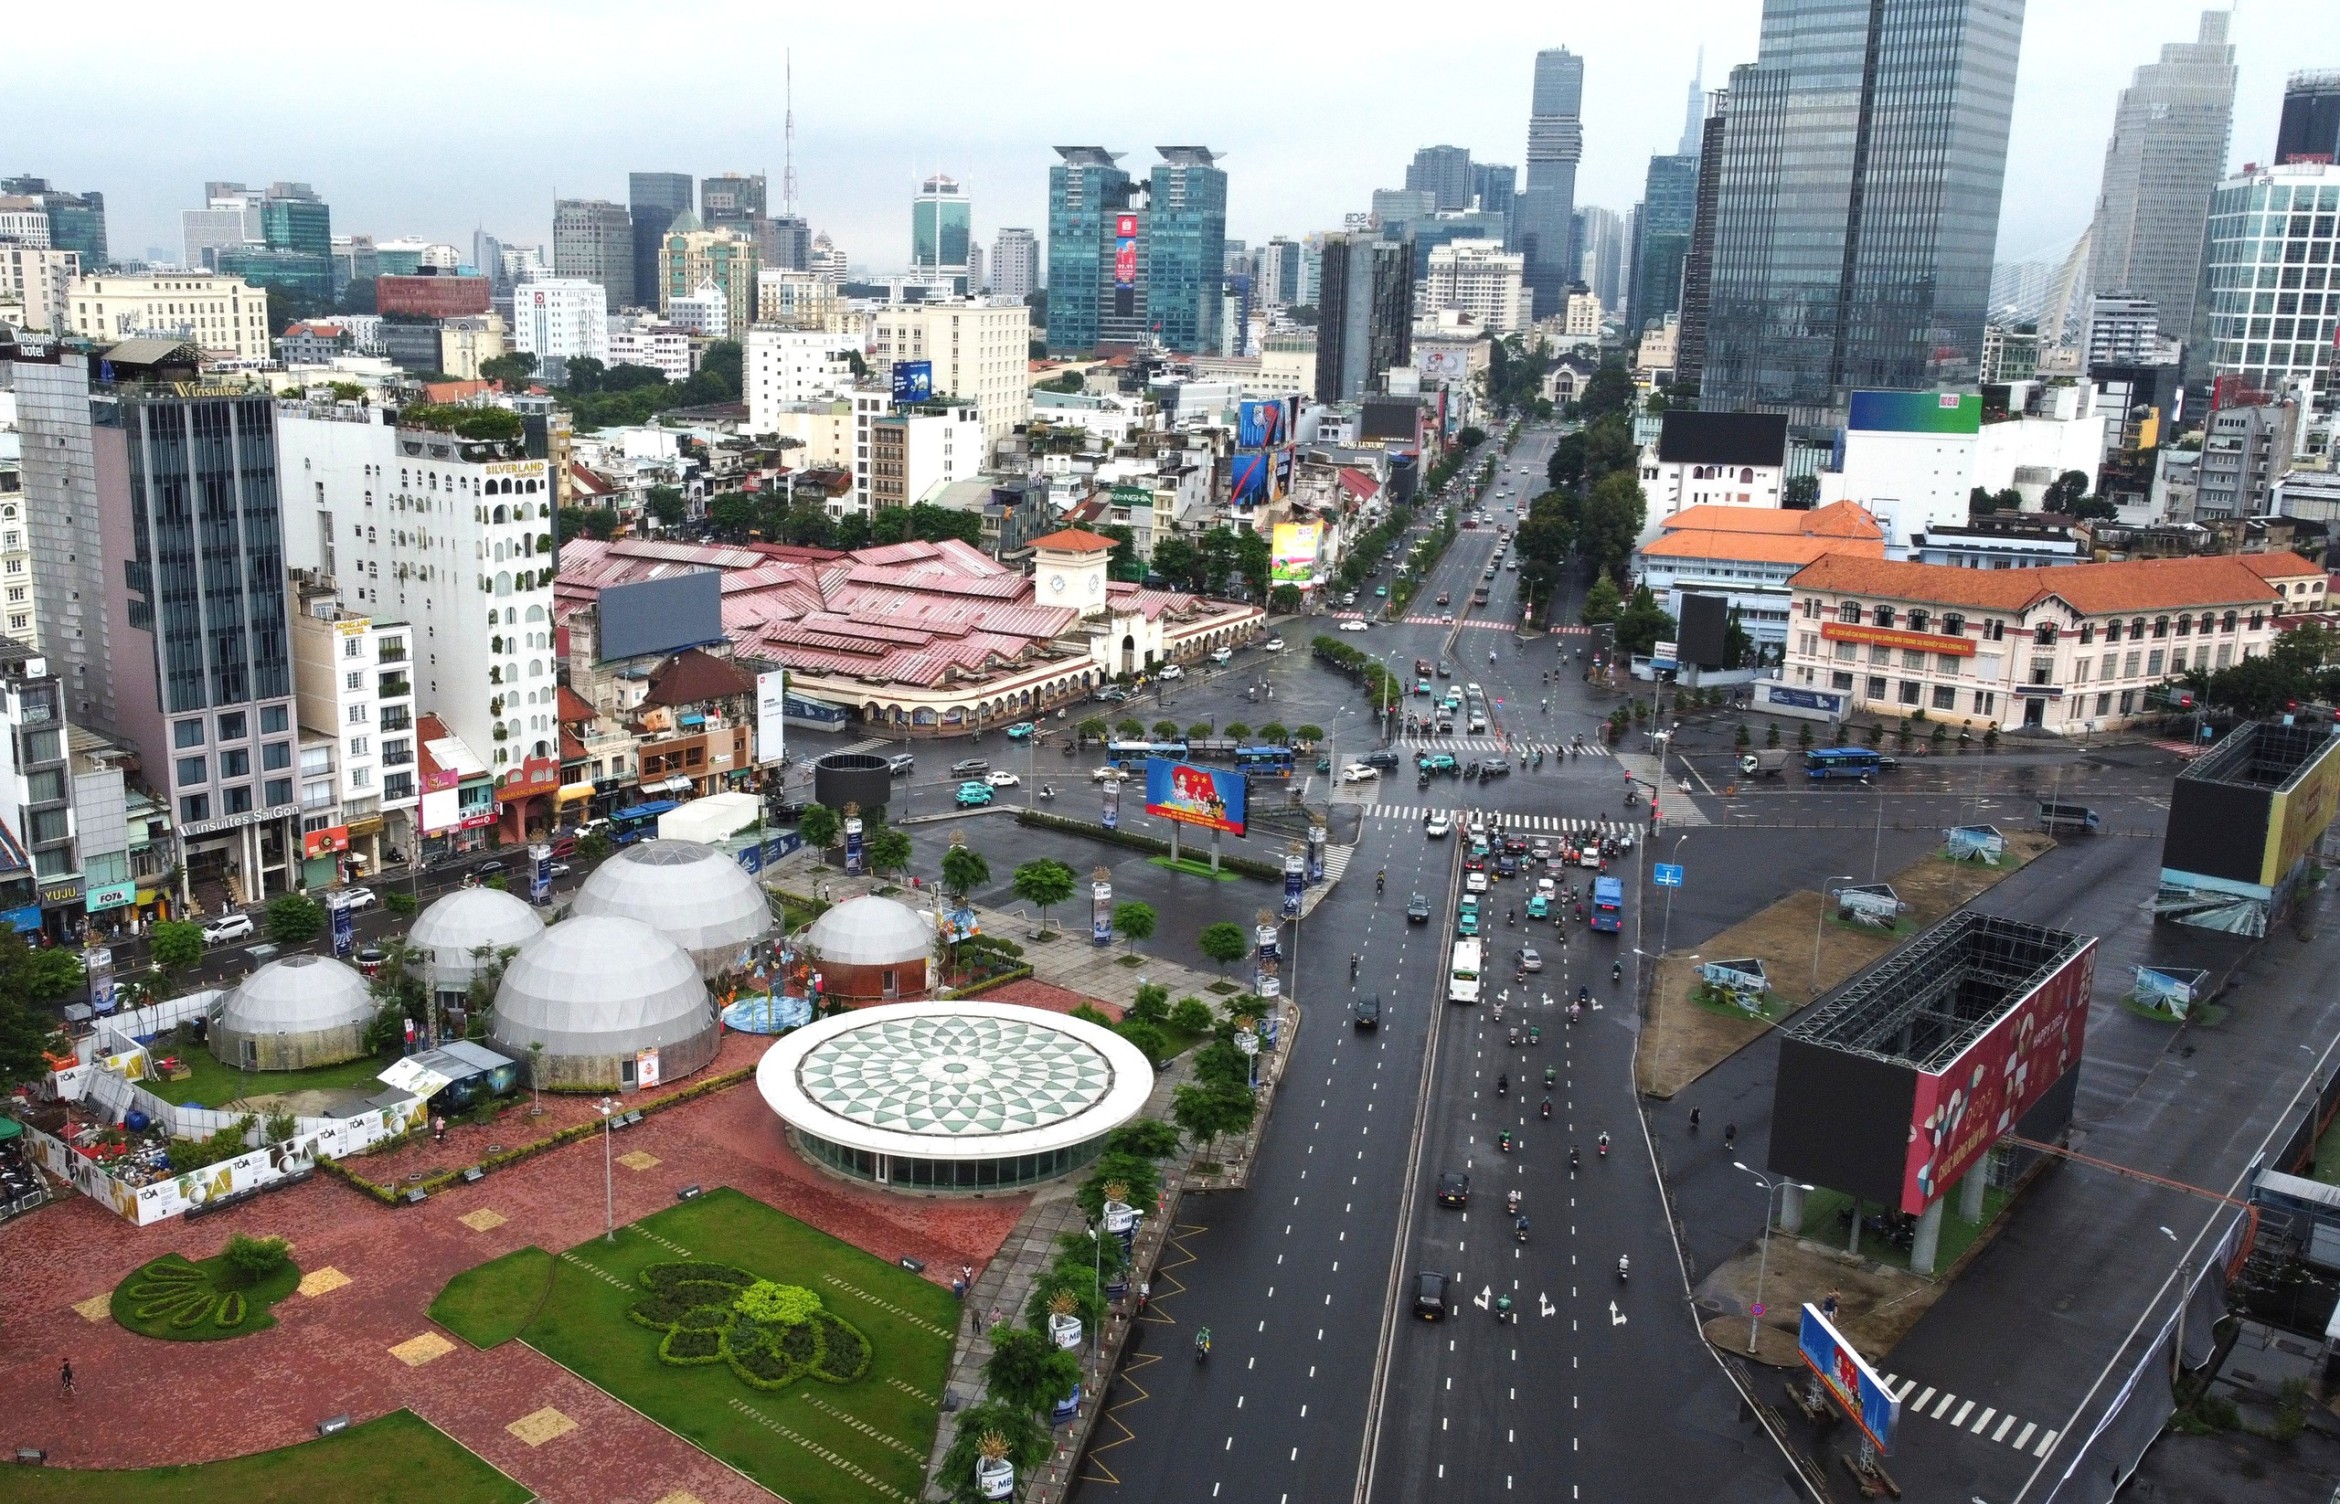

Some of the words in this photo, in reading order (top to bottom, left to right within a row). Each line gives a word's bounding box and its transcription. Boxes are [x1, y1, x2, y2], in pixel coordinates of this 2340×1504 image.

[20, 345, 46, 358] hotel
[1339, 440, 1357, 449] KING
[1357, 441, 1386, 449] LUXURY
[485, 462, 545, 475] SILVERLAND
[253, 804, 299, 822] SaiGon
[468, 817, 484, 826] CIRCLE
[44, 886, 77, 902] YUJU
[99, 891, 123, 904] FO76
[1119, 1216, 1133, 1225] MB
[1068, 1330, 1082, 1342] MB
[996, 1477, 1013, 1490] MB
